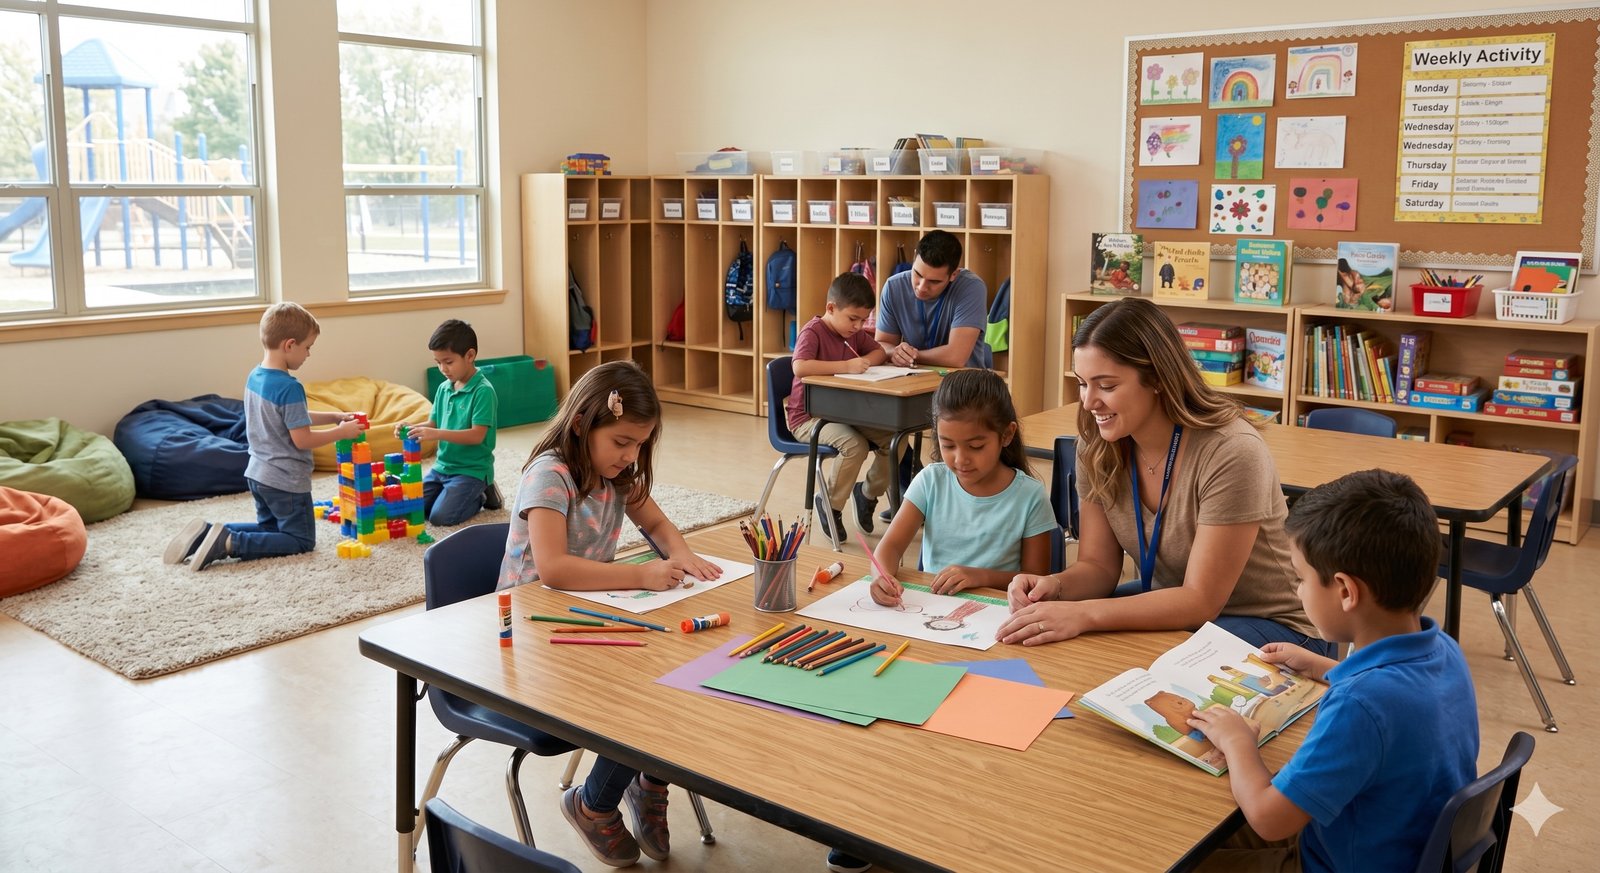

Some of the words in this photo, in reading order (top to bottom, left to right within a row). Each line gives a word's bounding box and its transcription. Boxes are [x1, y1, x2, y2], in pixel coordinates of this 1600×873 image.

[1414, 51, 1472, 67] Weekly
[1476, 47, 1541, 64] Activity
[1414, 84, 1449, 93] Monday
[1412, 102, 1449, 112] Tuesday
[1404, 122, 1454, 132] Wednesday
[1403, 141, 1454, 151] Wednesday
[1407, 161, 1447, 171] Thursday
[1411, 180, 1439, 190] Friday
[1405, 199, 1444, 209] Saturday
